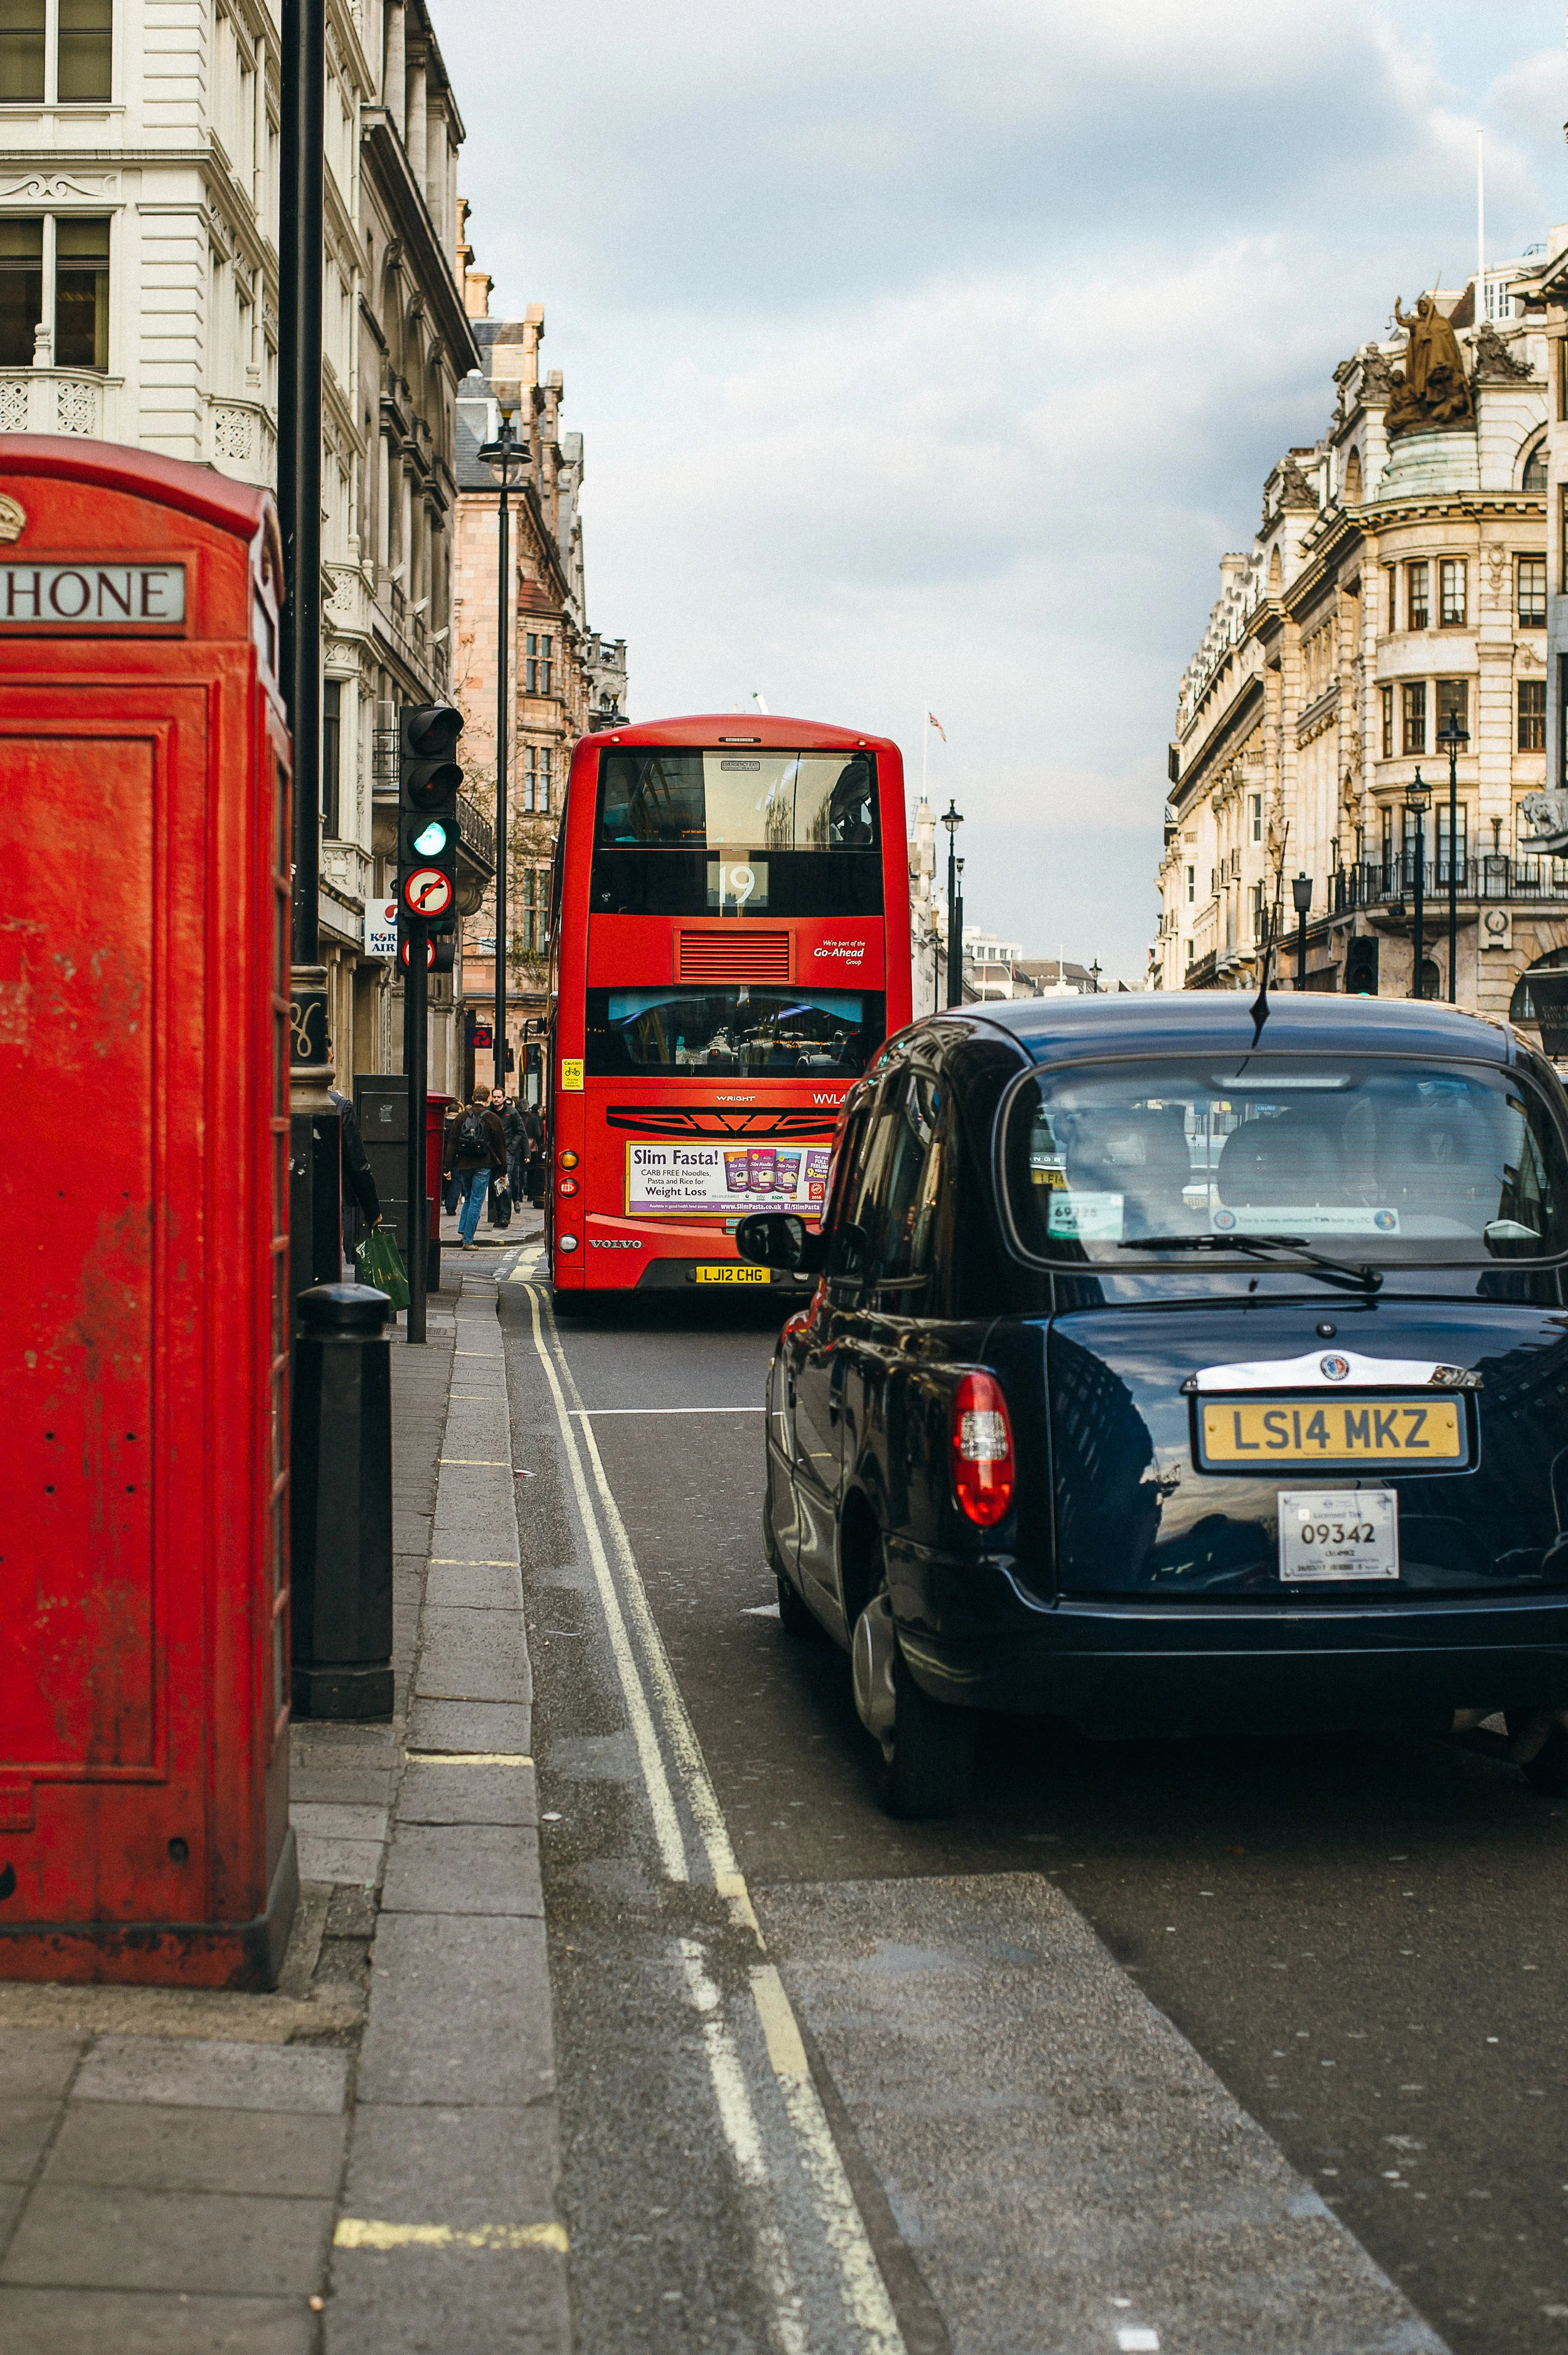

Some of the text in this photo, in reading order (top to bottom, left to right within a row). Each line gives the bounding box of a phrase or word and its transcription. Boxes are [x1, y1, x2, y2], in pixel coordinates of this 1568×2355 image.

[7, 571, 169, 617] HONE
[719, 865, 755, 904] 19
[370, 933, 398, 942] KOR
[371, 943, 395, 951] AIR
[813, 948, 865, 957] Go-Ahead
[634, 1149, 718, 1165] Slim Fasta!
[807, 1168, 814, 1177] 9
[645, 1187, 707, 1198] Weight Loss
[588, 1239, 642, 1249] VOLVO
[704, 1269, 763, 1281] LJ12 CHG
[1234, 1409, 1430, 1450] LS14 MKZ
[1301, 1523, 1375, 1545] 09342
